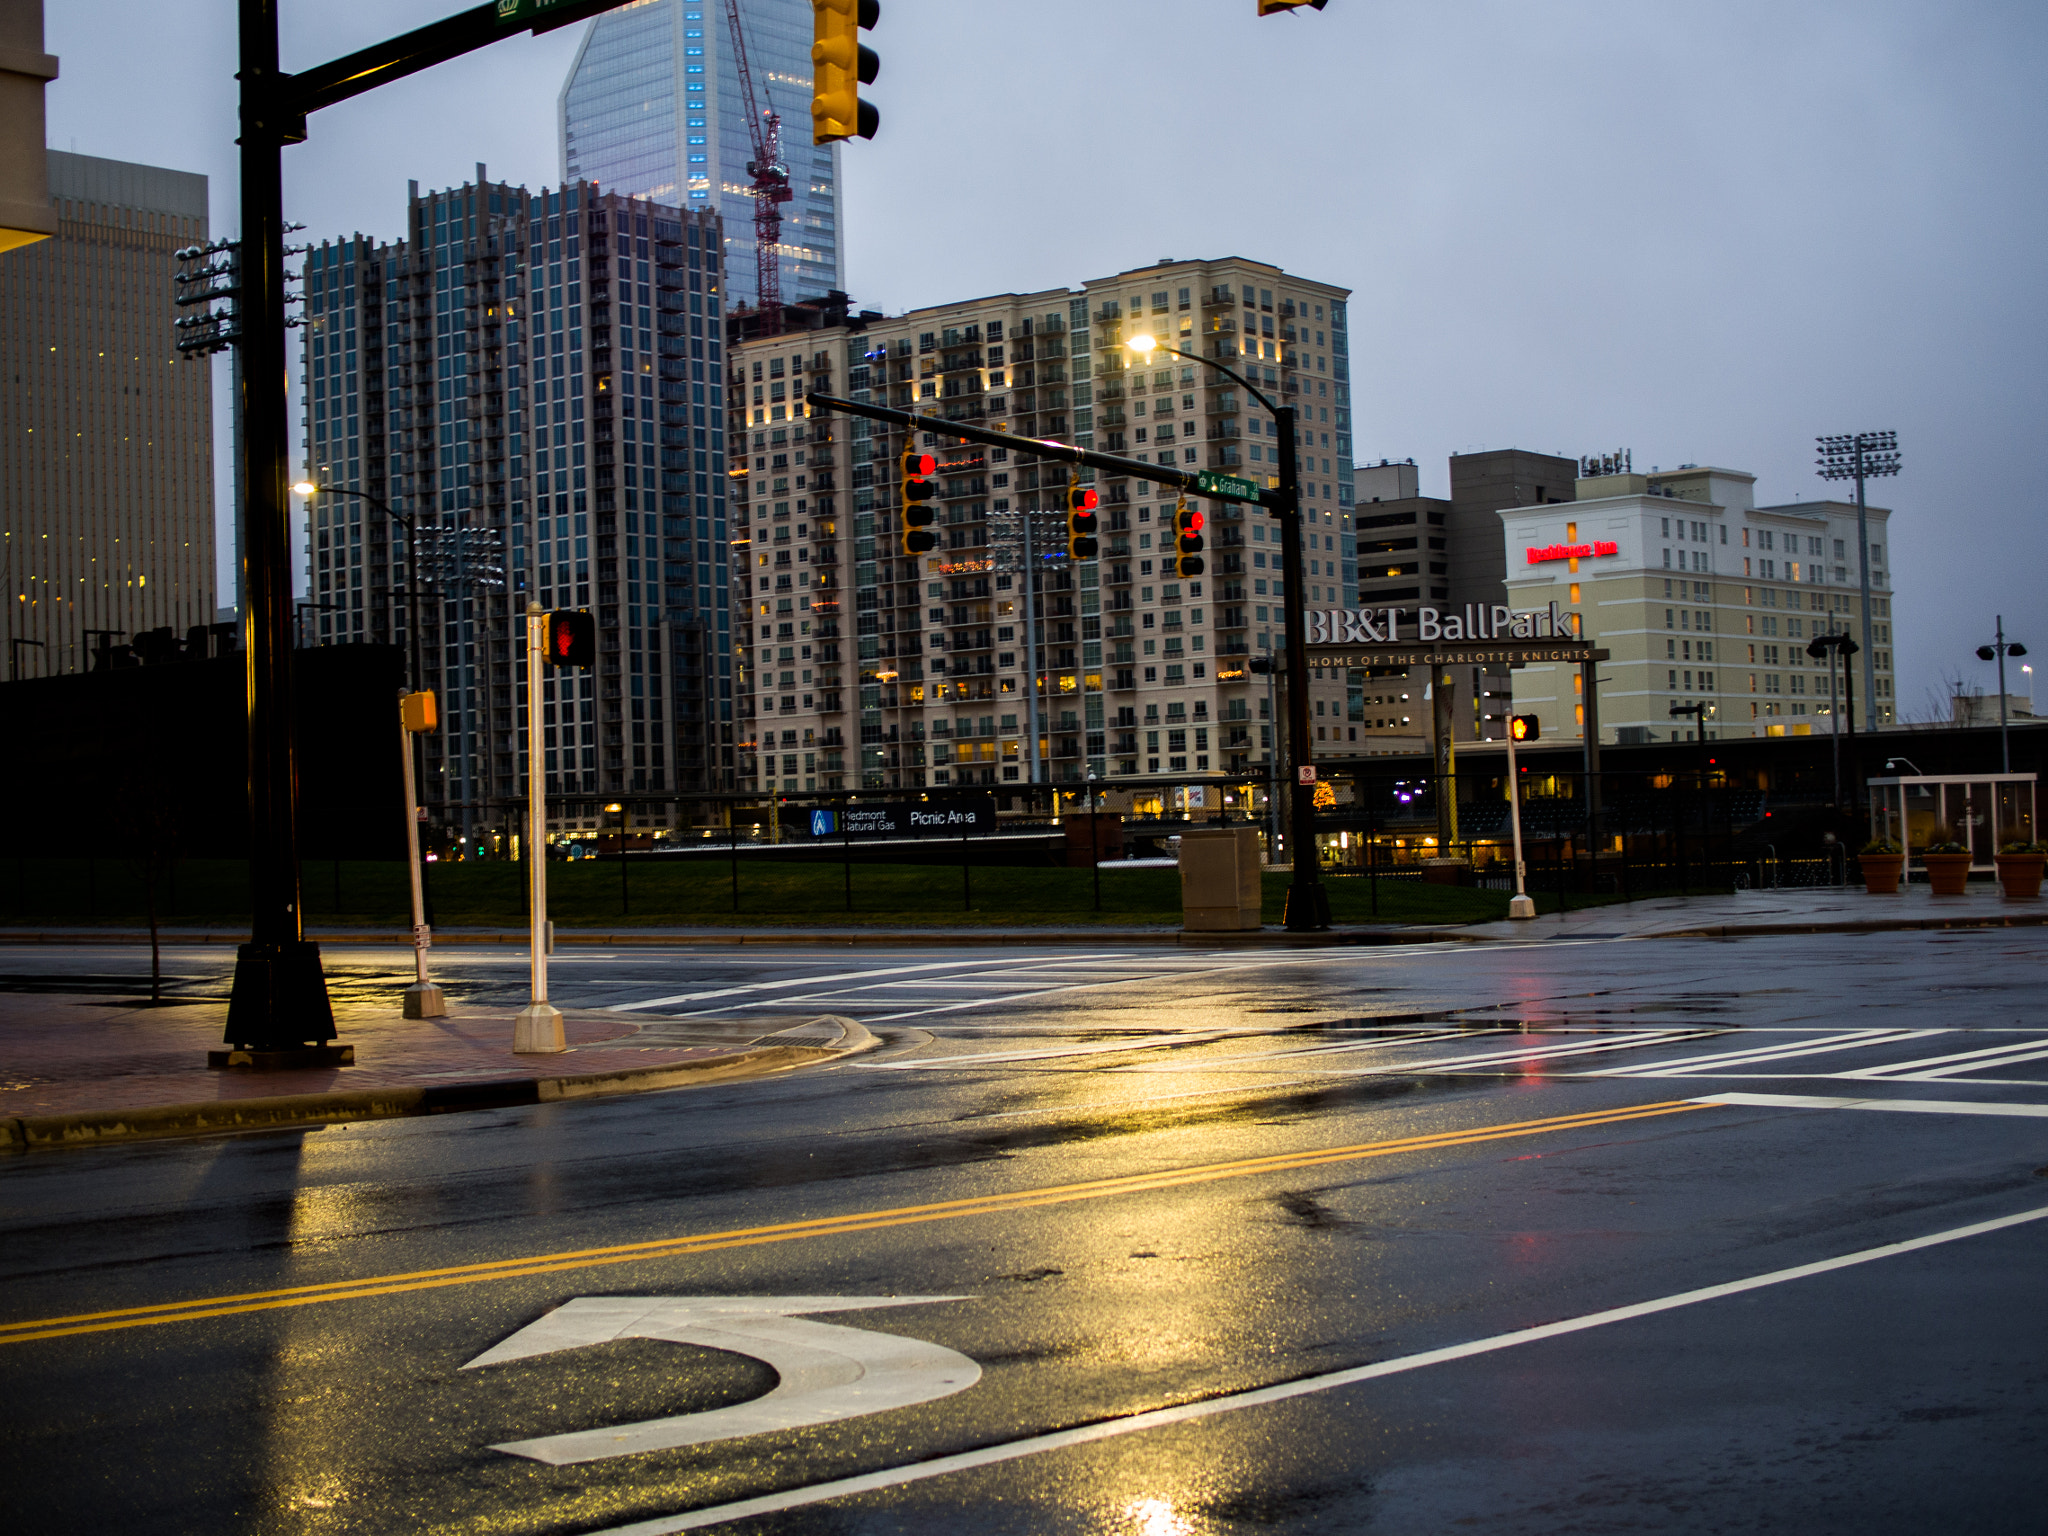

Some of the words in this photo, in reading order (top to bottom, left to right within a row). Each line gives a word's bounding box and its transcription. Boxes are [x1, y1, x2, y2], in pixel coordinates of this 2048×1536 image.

[1219, 478, 1247, 496] Graham
[1526, 543, 1592, 564] Residence
[1593, 540, 1618, 557] Inn
[1304, 608, 1406, 644] BB&T
[1418, 601, 1573, 641] BallPark
[1309, 656, 1353, 667] HOME
[1361, 656, 1379, 665] OF
[1388, 655, 1415, 665] THE
[1424, 652, 1514, 664] CHARLOTTE
[1521, 649, 1590, 661] KNIGHTS
[877, 820, 895, 830] Gas
[910, 810, 945, 825] Picnic
